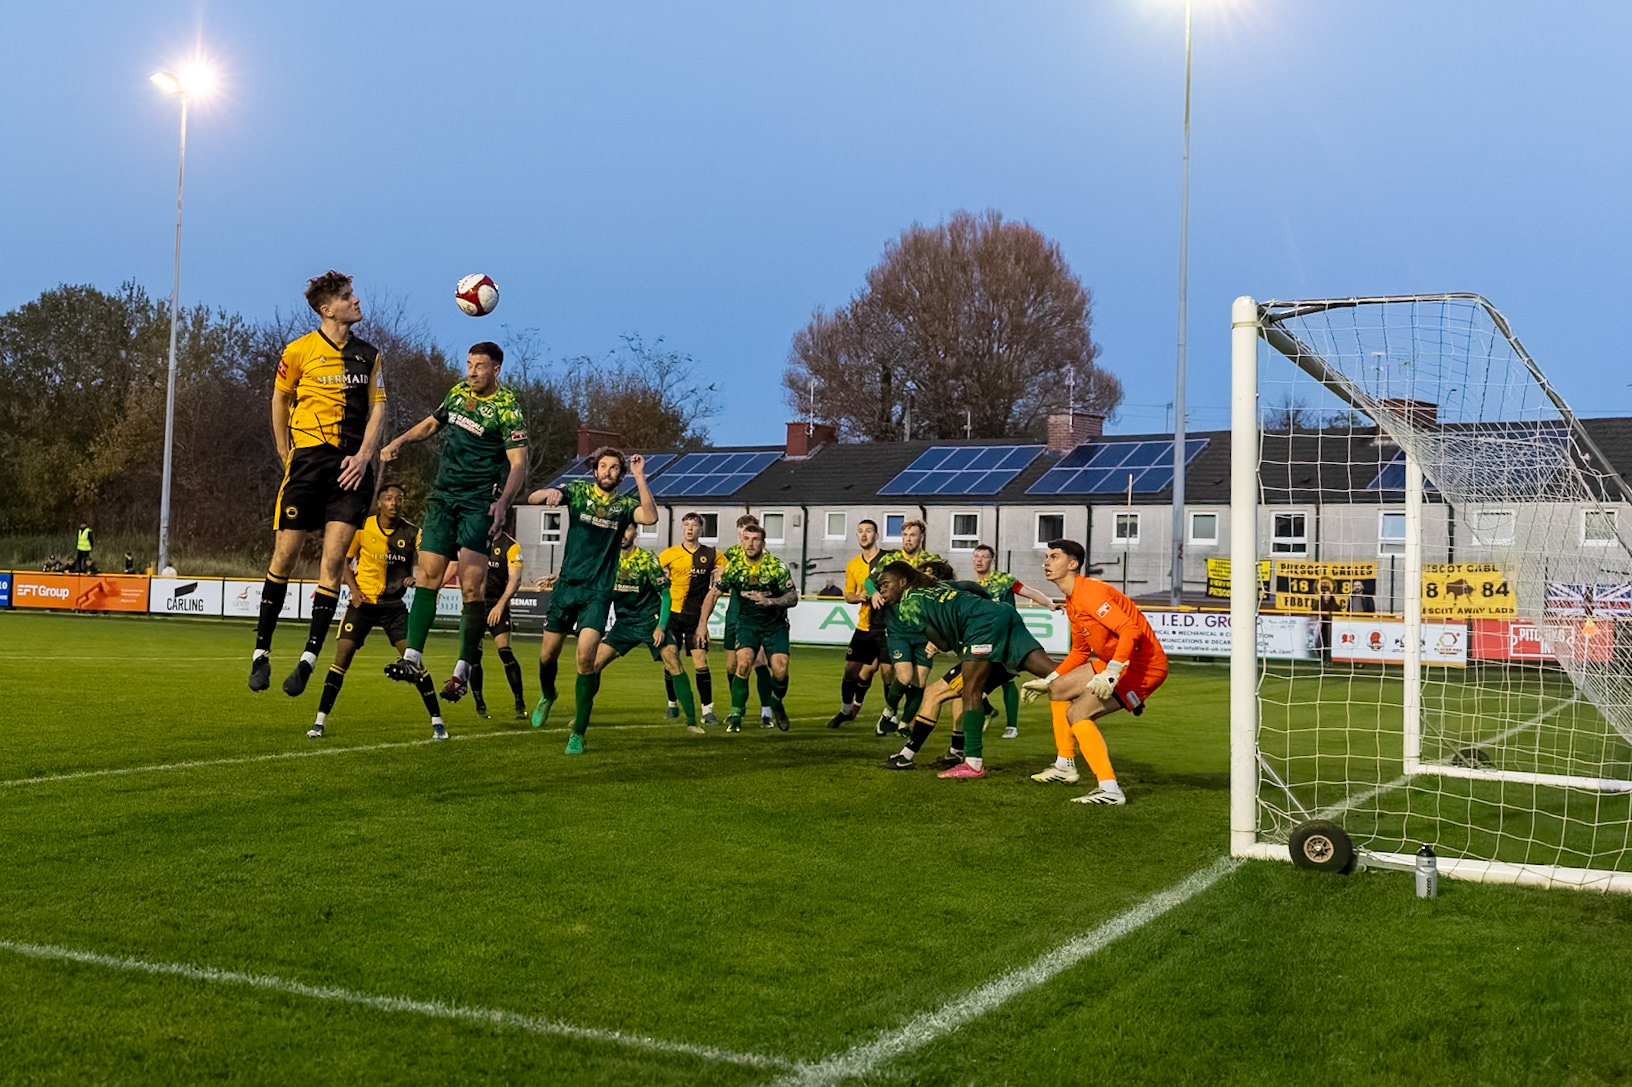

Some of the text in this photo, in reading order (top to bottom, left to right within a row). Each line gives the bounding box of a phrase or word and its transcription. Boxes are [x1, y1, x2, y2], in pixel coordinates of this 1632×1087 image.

[316, 374, 369, 384] MERMAID
[1280, 563, 1328, 576] PRESCOT
[1332, 564, 1373, 577] CABLES
[1423, 564, 1462, 573] ESCOT
[1290, 580, 1309, 592] 18
[1421, 581, 1510, 598] 8 84
[166, 598, 204, 612] CARLING
[510, 598, 538, 606] SENATE
[1284, 596, 1314, 608] FOOT
[1162, 614, 1231, 628] I.E.D. GR
